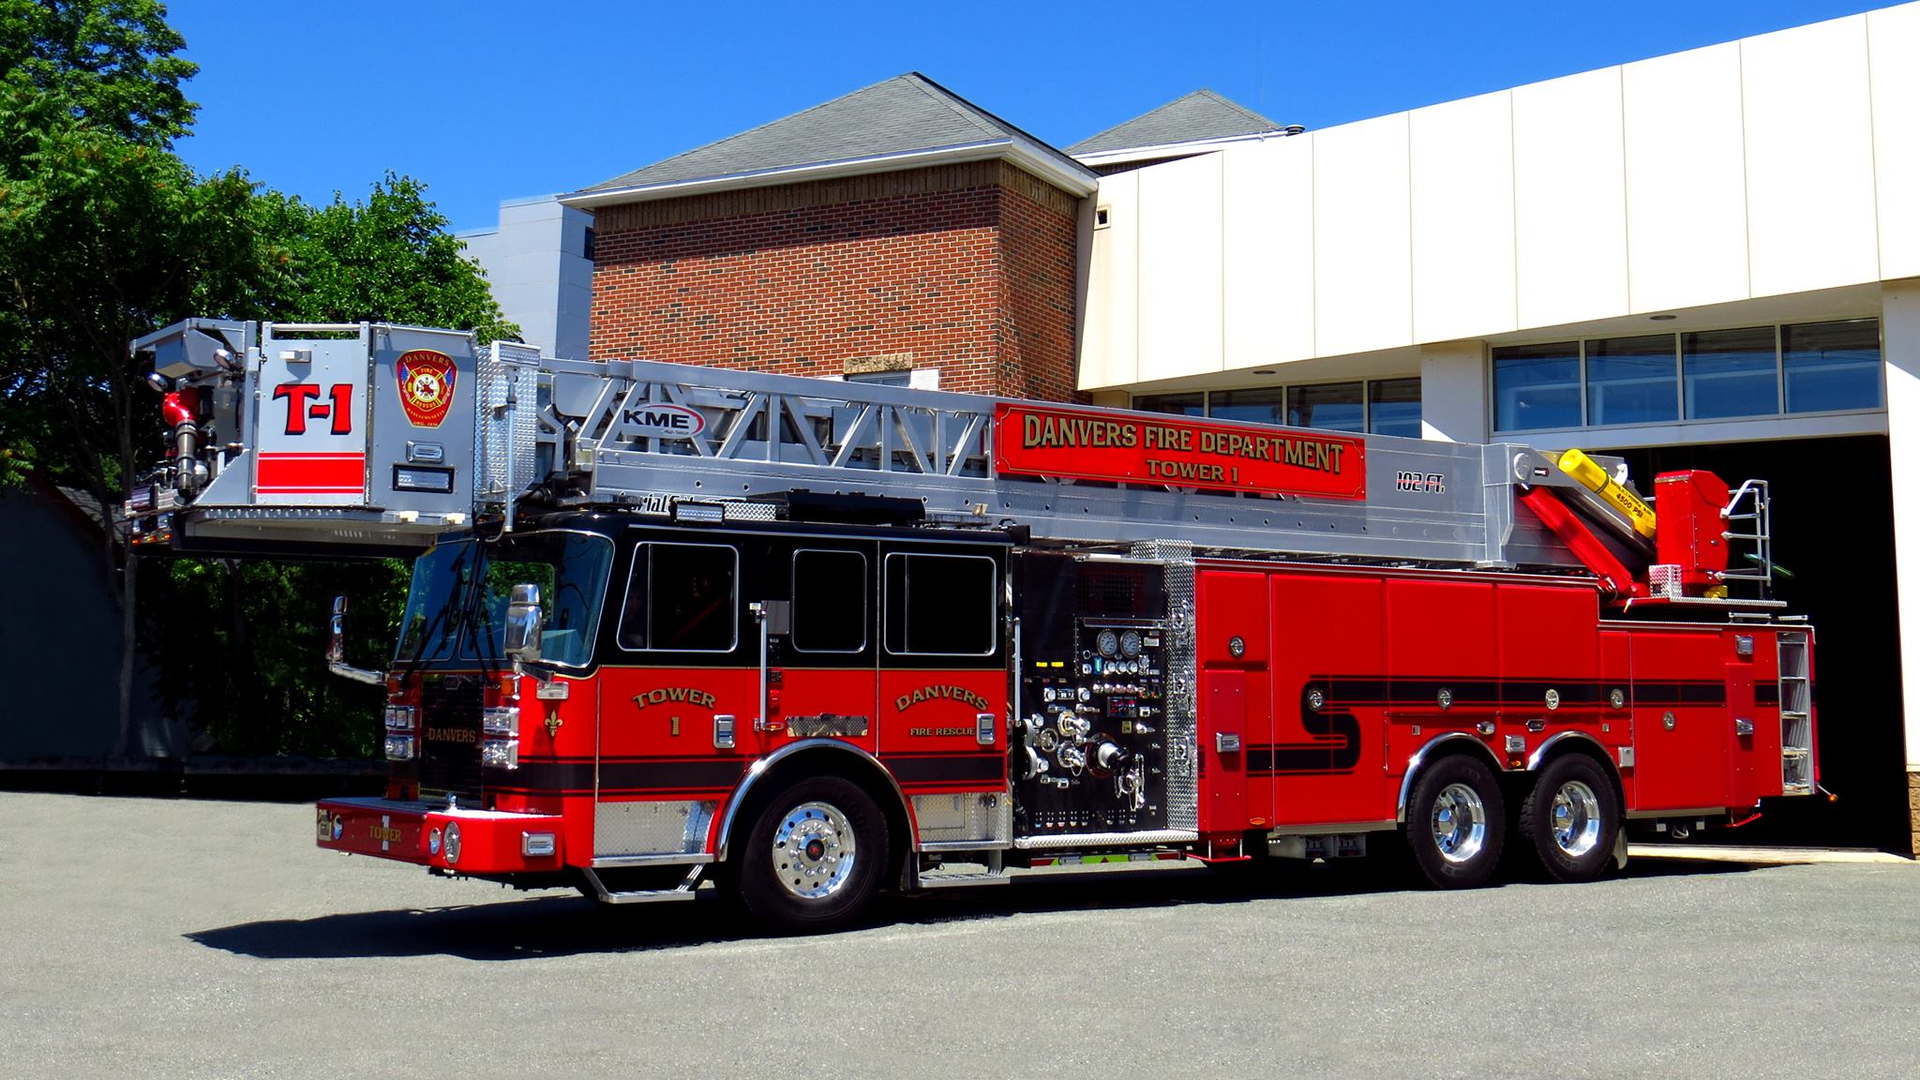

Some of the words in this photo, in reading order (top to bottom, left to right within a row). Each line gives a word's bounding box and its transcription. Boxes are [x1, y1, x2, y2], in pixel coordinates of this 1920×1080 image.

[404, 353, 450, 367] DANVERS
[272, 384, 353, 435] T-1
[623, 409, 690, 429] KME
[1023, 414, 1137, 448] DANVERS
[1145, 426, 1193, 451] FIRE
[1200, 431, 1344, 474] DEPARTMENT
[1146, 459, 1225, 482] TOWER
[1231, 467, 1239, 482] 1
[1396, 471, 1423, 492] 102
[1424, 473, 1445, 494] FT.
[1616, 493, 1633, 509] 4500
[1632, 506, 1644, 518] PSI
[632, 687, 717, 710] TOWER
[895, 685, 989, 711] DANVERS
[428, 727, 476, 743] DANVERS
[671, 716, 680, 736] 1
[910, 727, 933, 736] FIRE
[935, 727, 976, 736] RESCUE
[369, 825, 401, 842] TOWER
